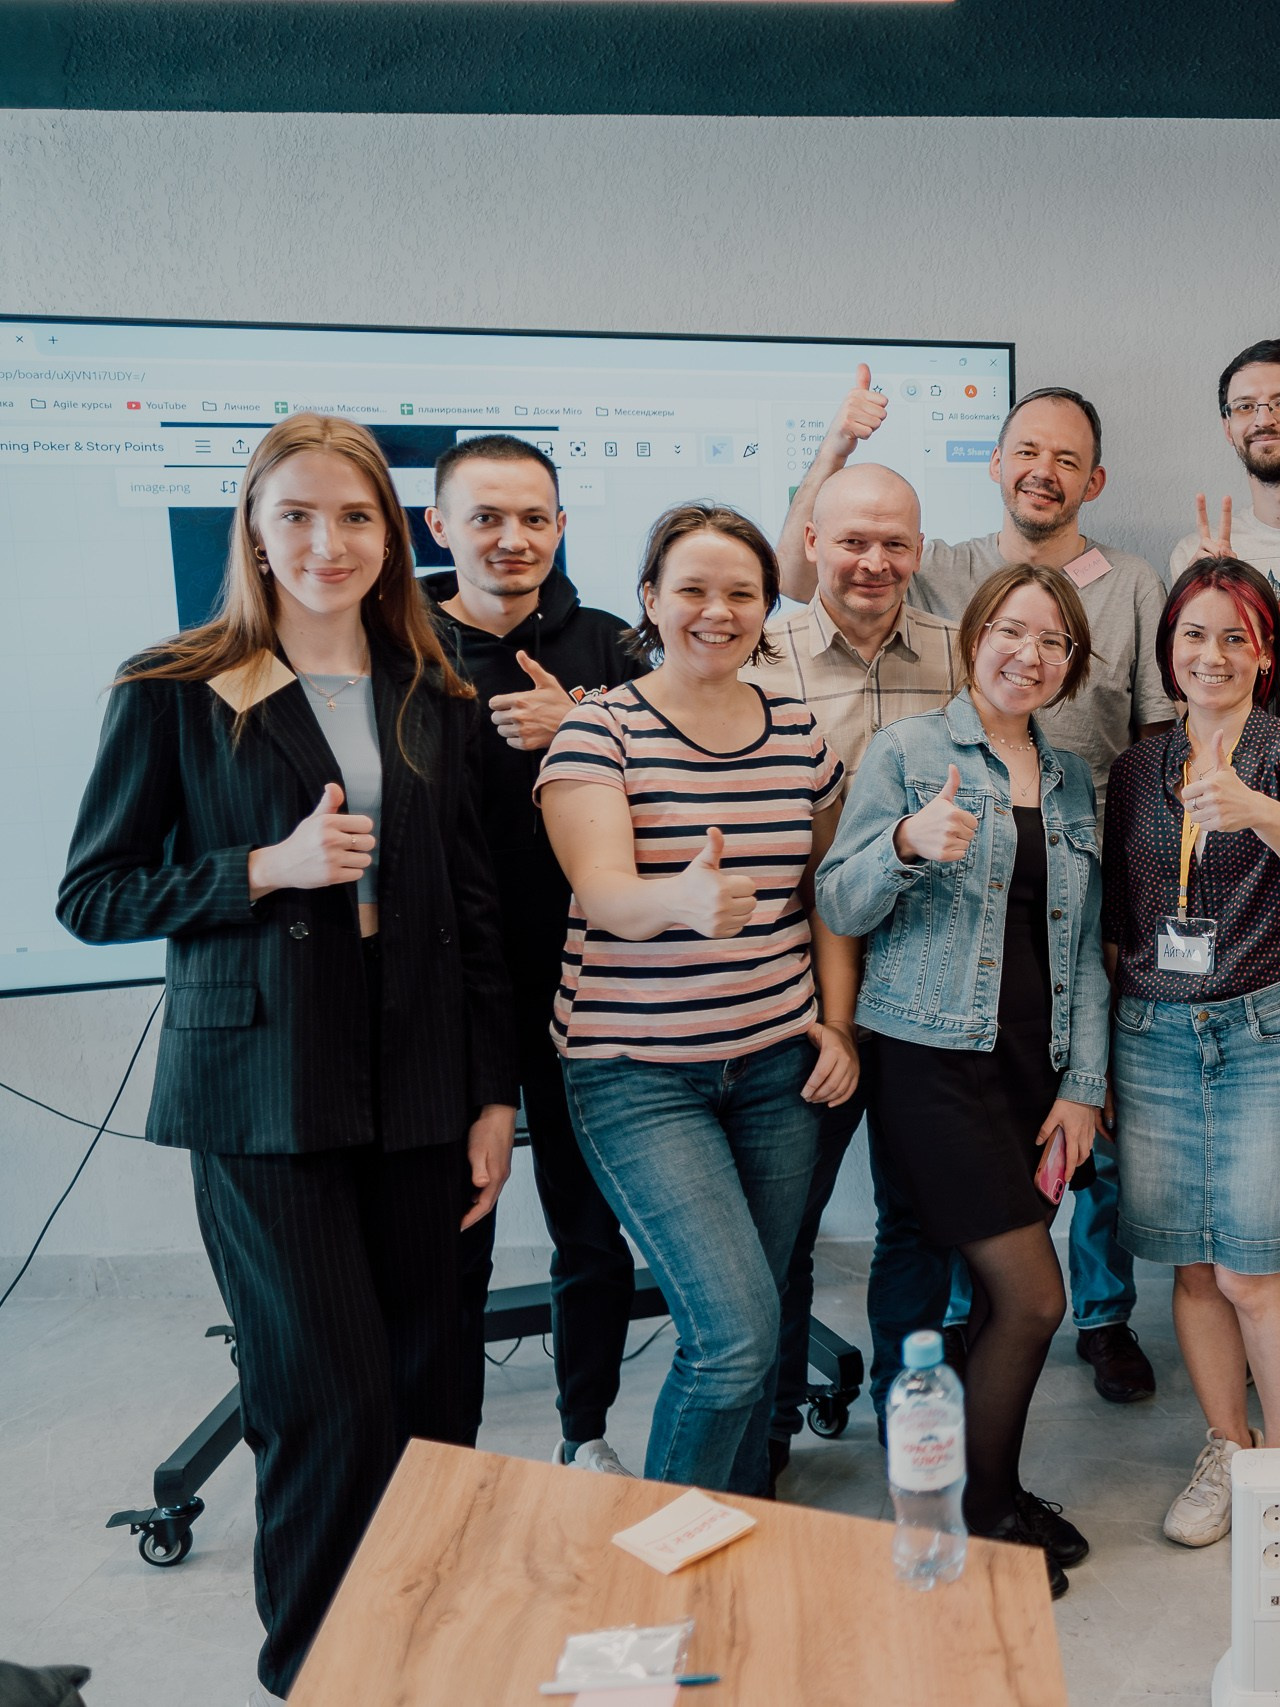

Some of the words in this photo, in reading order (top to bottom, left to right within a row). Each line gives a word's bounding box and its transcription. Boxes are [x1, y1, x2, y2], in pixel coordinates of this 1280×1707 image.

[53, 399, 79, 410] Agile
[81, 401, 112, 411] курсы
[146, 401, 187, 410] YouTube
[223, 402, 261, 411] Личное
[418, 406, 483, 415] планирование
[533, 407, 560, 416] Доски
[563, 407, 582, 415] Miro
[614, 408, 675, 418] Мессенджеры
[948, 413, 958, 421] All
[960, 413, 1000, 421] Bookmarks
[800, 419, 806, 428] 2
[808, 419, 825, 428] min
[800, 433, 807, 442] 5
[0, 441, 29, 454] ning
[33, 441, 70, 452] Poker
[74, 442, 83, 452] &
[86, 442, 121, 454] Story
[124, 442, 164, 452] Points
[802, 447, 812, 456] 10
[967, 448, 990, 456] Share
[130, 482, 191, 495] image.png
